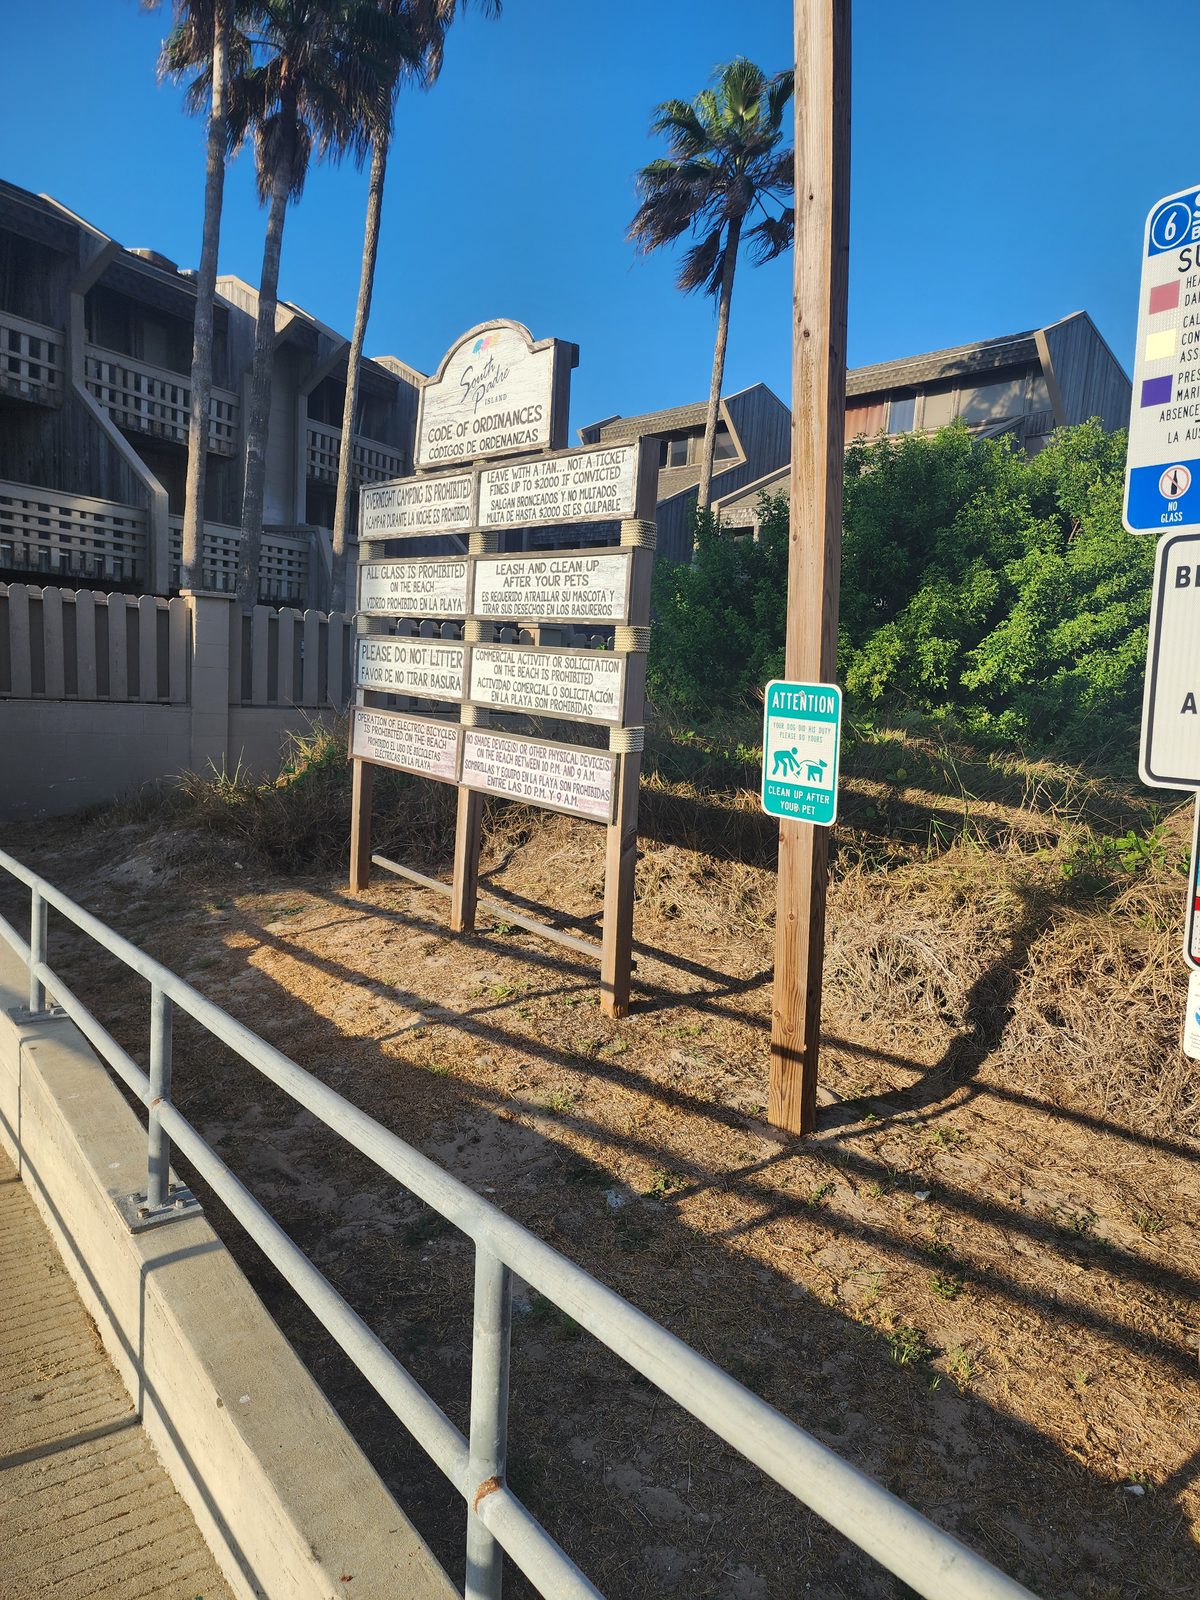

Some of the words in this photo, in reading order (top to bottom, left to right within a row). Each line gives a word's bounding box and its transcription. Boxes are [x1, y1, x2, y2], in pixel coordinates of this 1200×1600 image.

[1165, 211, 1177, 240] 6
[460, 355, 495, 402] South
[473, 364, 510, 413] Padre
[485, 394, 507, 405] ISLAND
[428, 425, 452, 443] CODE
[456, 421, 469, 437] OF
[473, 405, 542, 433] ORDINANCES
[429, 443, 464, 460] CÓDIGOS
[467, 440, 476, 453] DE
[480, 429, 538, 450] ORDENANZAS
[1168, 432, 1178, 443] LA
[487, 469, 509, 483] LEAVE
[512, 466, 530, 479] WITH
[533, 467, 539, 476] A
[568, 458, 583, 471] NOT
[586, 456, 592, 467] A
[596, 450, 626, 465] TICKET
[490, 483, 509, 496] FINES
[511, 481, 520, 492] UP
[523, 479, 532, 491] TO
[535, 476, 559, 489] $2000
[562, 474, 571, 486] IF
[573, 466, 621, 484] CONVICTED
[366, 490, 395, 510] OVERNIGHT
[397, 486, 423, 506] CAMPING
[425, 485, 432, 502] IS
[434, 479, 471, 501] PROHIBITED
[491, 498, 515, 510] SALGAN
[517, 493, 558, 507] BRONCEADOS
[560, 491, 566, 502] Y
[568, 490, 577, 500] NO
[580, 485, 617, 499] MULTADOS
[1168, 501, 1177, 511] NO
[408, 511, 414, 525] LA
[416, 509, 432, 525] NOCHE
[433, 509, 439, 523] ES
[442, 506, 469, 522] PROHIBIDO
[487, 511, 504, 523] MULTA
[507, 510, 514, 521] DE
[516, 507, 536, 520] HASTA
[539, 506, 560, 518] $2000
[563, 505, 571, 515] SI
[573, 503, 581, 514] ES
[584, 499, 621, 513] CULPABLE
[1161, 512, 1182, 523] GLASS
[367, 567, 378, 579] ALL
[381, 566, 405, 579] GLASS
[408, 566, 415, 578] IS
[419, 564, 465, 578] PROHIBITED
[496, 564, 524, 575] LEASH
[528, 563, 546, 575] AND
[550, 561, 582, 573] CLEAN
[586, 560, 599, 571] UP
[390, 582, 398, 592] ON
[401, 582, 411, 592] THE
[413, 581, 434, 592] BEACH
[503, 576, 530, 587] AFTER
[535, 575, 560, 587] YOUR
[564, 575, 589, 586] PETS
[367, 598, 385, 609] VIDRIO
[387, 598, 417, 610] PROHIBIDO
[420, 598, 427, 610] EN
[429, 598, 437, 610] LA
[440, 598, 462, 611] PLAYA
[482, 592, 488, 602] ES
[491, 592, 522, 603] REQUERIDO
[525, 591, 559, 602] ATRAILLAR
[562, 591, 570, 602] SU
[573, 591, 606, 602] MASCOTA
[610, 590, 614, 602] Y
[483, 604, 499, 614] TIRAR
[501, 604, 512, 614] SUS
[514, 604, 544, 615] DESECHOS
[547, 604, 554, 615] EN
[557, 604, 568, 615] LOS
[572, 604, 612, 616] BASUREROS
[362, 645, 391, 662] PLEASE
[395, 647, 406, 663] DO
[410, 649, 427, 665] NOT
[430, 650, 463, 669] LITTER
[475, 650, 515, 664] COMMERCIAL
[518, 654, 550, 666] ACTIVITY
[553, 657, 562, 667] OR
[565, 658, 619, 673] SOLICITATION
[362, 667, 382, 681] FAVOR
[385, 669, 392, 682] DE
[395, 670, 404, 683] NO
[407, 671, 427, 686] TIRAR
[431, 674, 461, 691] BASURA
[494, 665, 502, 675] ON
[505, 666, 515, 677] THE
[518, 666, 539, 679] BEACH
[542, 669, 549, 680] IS
[552, 670, 593, 685] PROHIBITED
[477, 678, 511, 691] ACTIVIDAD
[513, 681, 550, 695] COMERCIAL
[553, 686, 557, 695] O
[560, 687, 613, 704] SOLICITACIÓN
[772, 691, 834, 714] ATTENTION
[491, 691, 499, 701] EN
[501, 692, 508, 703] LA
[511, 693, 532, 706] PLAYA
[535, 697, 548, 708] SON
[550, 699, 592, 715] PROHIBIDAS
[357, 713, 386, 726] OPERATION
[388, 720, 395, 728] OF
[398, 721, 424, 734] ELECTRIC
[426, 726, 456, 740] BICYCLES
[364, 724, 370, 733] IS
[372, 726, 403, 740] PROHIBITED
[405, 733, 412, 742] ON
[415, 734, 424, 744] THE
[427, 736, 446, 749] BEACH
[780, 732, 796, 740] PLEASE
[368, 737, 388, 749] PROHIBIDO
[466, 734, 473, 745] NO
[474, 736, 490, 748] SHADE
[520, 743, 527, 753] OR
[529, 745, 546, 759] OTHER
[549, 749, 578, 764] PHYSICAL
[415, 758, 430, 770] PLAYA
[477, 748, 484, 757] ON
[486, 750, 494, 761] THE
[496, 751, 513, 765] BEACH
[515, 755, 540, 769] BETWEEN
[542, 761, 548, 771] 10
[563, 765, 575, 777] AND
[577, 768, 581, 778] 9
[465, 760, 494, 775] SOMBRILLAS
[495, 765, 500, 776] Y
[501, 767, 520, 781] EQUIPO
[522, 771, 529, 782] EN
[530, 773, 537, 784] LA
[539, 775, 558, 789] PLAYA
[560, 779, 571, 791] SON
[573, 783, 609, 801] PROHIBIDAS
[487, 776, 506, 789] ENTRE
[508, 780, 521, 793] LAS
[524, 783, 532, 794] 10
[549, 789, 554, 800] Y
[557, 792, 561, 802] 9
[768, 785, 790, 797] CLEAN
[794, 791, 803, 799] UP
[806, 792, 829, 804] AFTER
[780, 801, 799, 812] YOUR
[802, 805, 815, 815] PET
